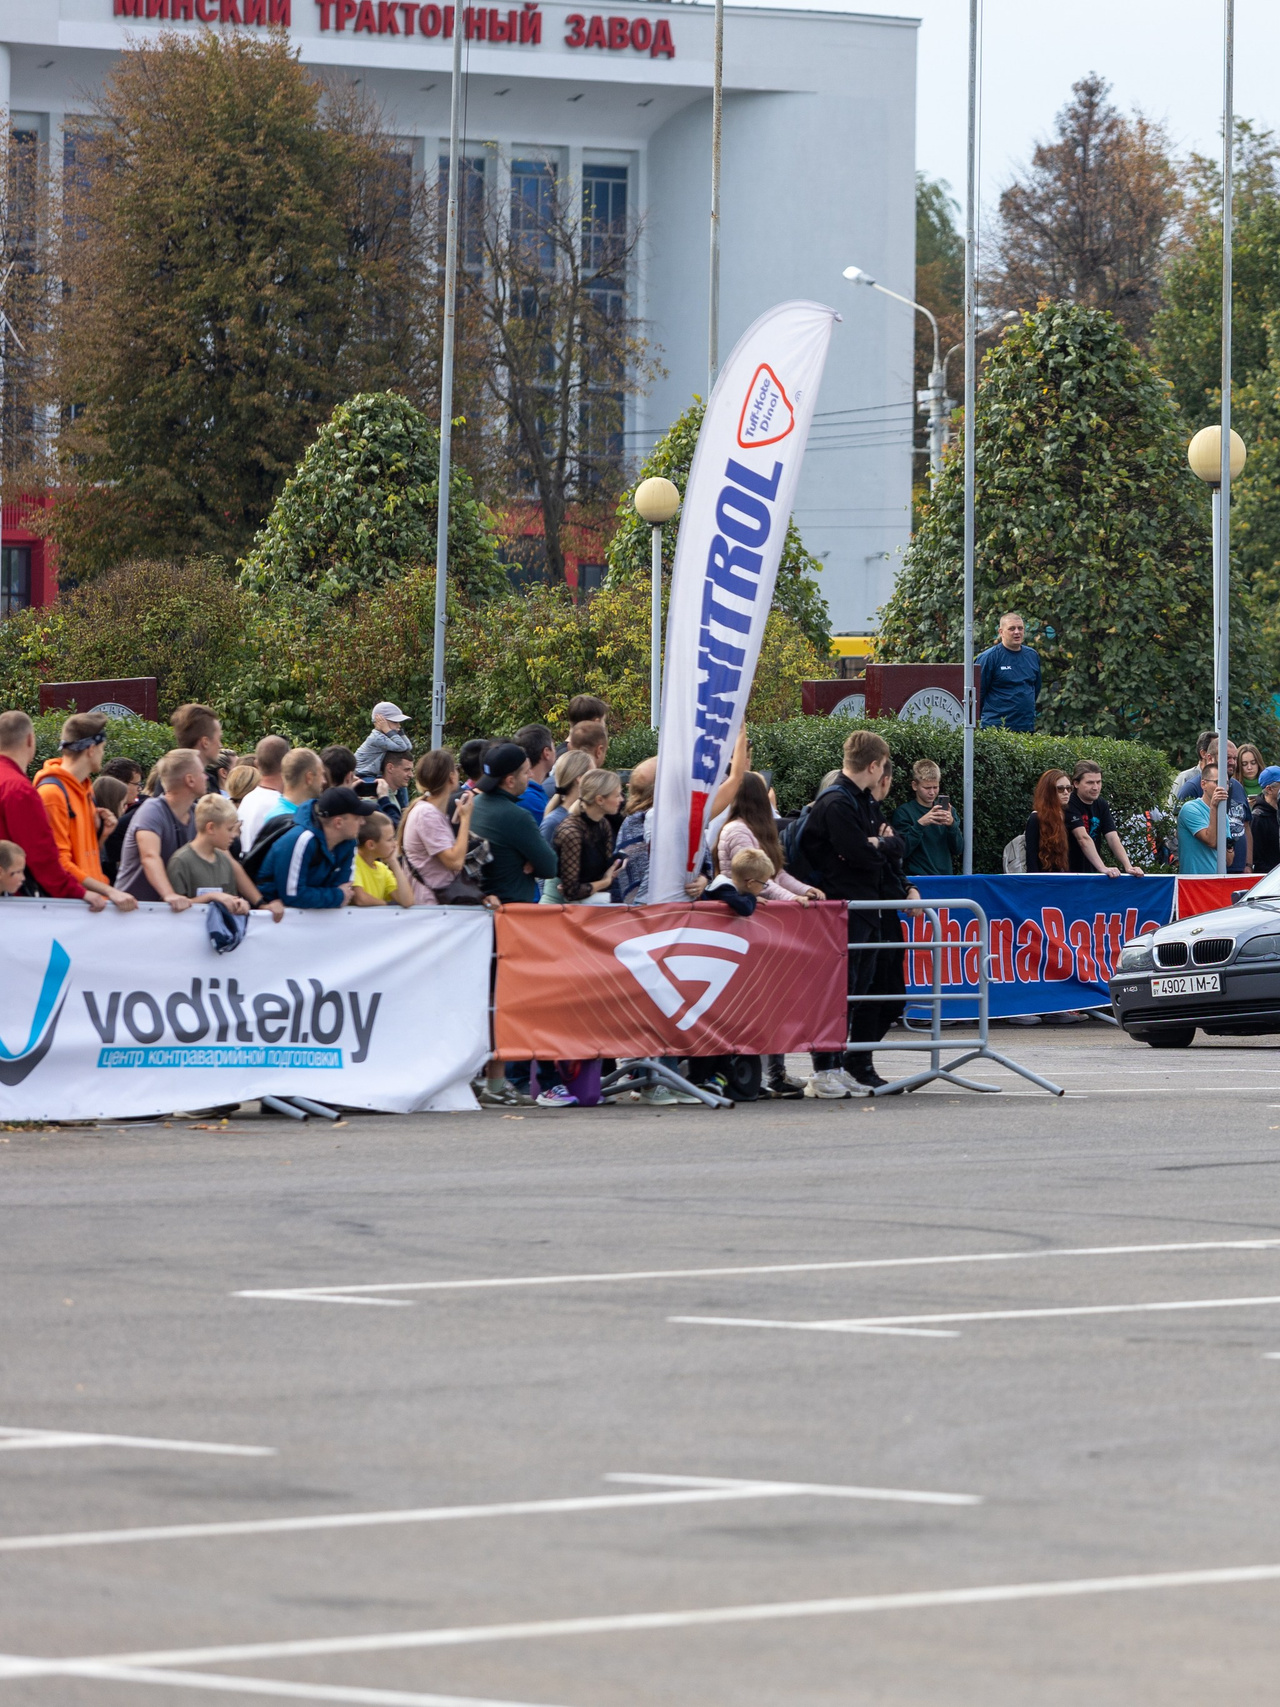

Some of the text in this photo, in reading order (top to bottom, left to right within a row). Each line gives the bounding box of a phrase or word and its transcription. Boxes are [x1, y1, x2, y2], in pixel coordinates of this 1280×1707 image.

[316, 0, 542, 44] ТРАКТОРНЫЙ
[565, 14, 675, 59] ЗАВОД
[745, 378, 770, 437] Tuff-Kote
[759, 392, 779, 432] Dinol
[1162, 978, 1186, 994] 4902
[82, 977, 382, 1063] voditel.by
[102, 1050, 144, 1067] центр
[267, 1050, 340, 1067] подготовки
